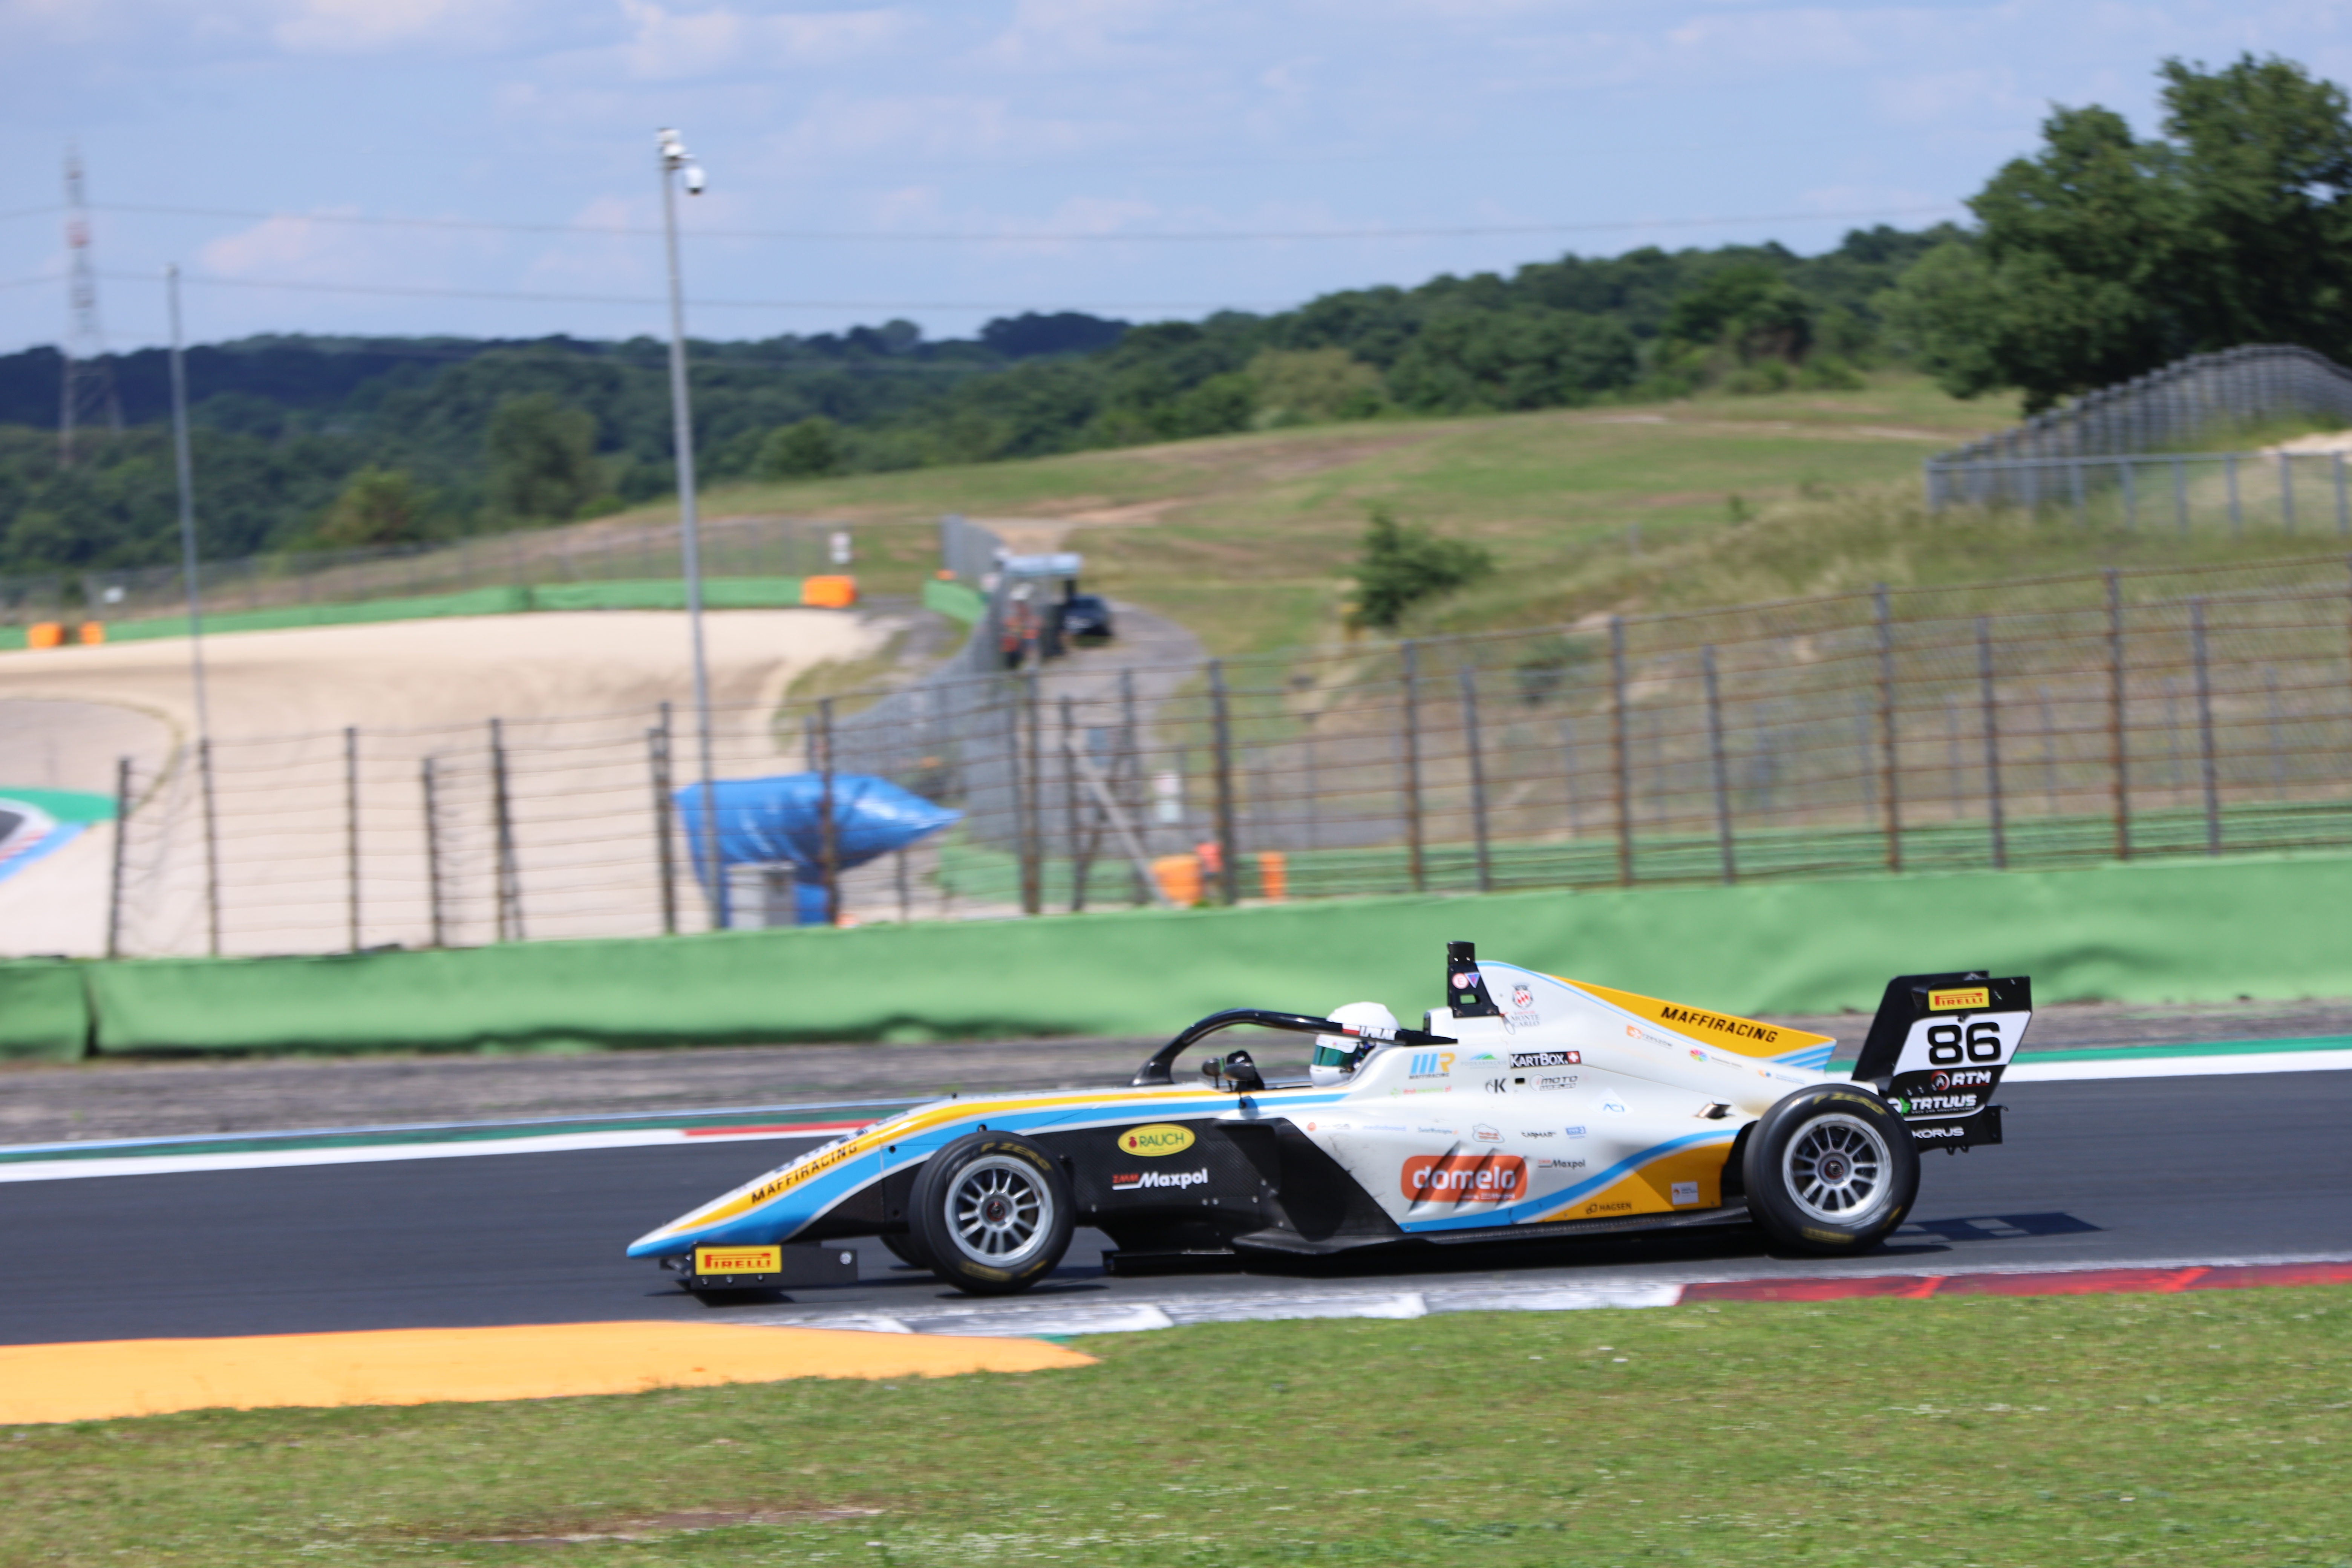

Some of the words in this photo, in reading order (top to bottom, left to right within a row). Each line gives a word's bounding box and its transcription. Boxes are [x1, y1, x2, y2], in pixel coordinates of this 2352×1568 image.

[1935, 993, 1983, 1006] PIRELLI
[1661, 1007, 1778, 1043] MAFFIRACING
[1928, 1022, 2001, 1066] 86
[1541, 1075, 1579, 1085] MOTO
[1910, 1094, 1977, 1110] TATUUS
[1139, 1132, 1185, 1148] RAUCH
[1911, 1126, 1965, 1138] KORUS
[751, 1142, 857, 1203] MAFFIRACING
[1552, 1159, 1586, 1170] Maxpol
[1138, 1167, 1208, 1190] Maxpol
[1412, 1165, 1516, 1190] domelo
[1599, 1202, 1632, 1211] HAGSEN
[704, 1253, 771, 1269] PIRELLI
